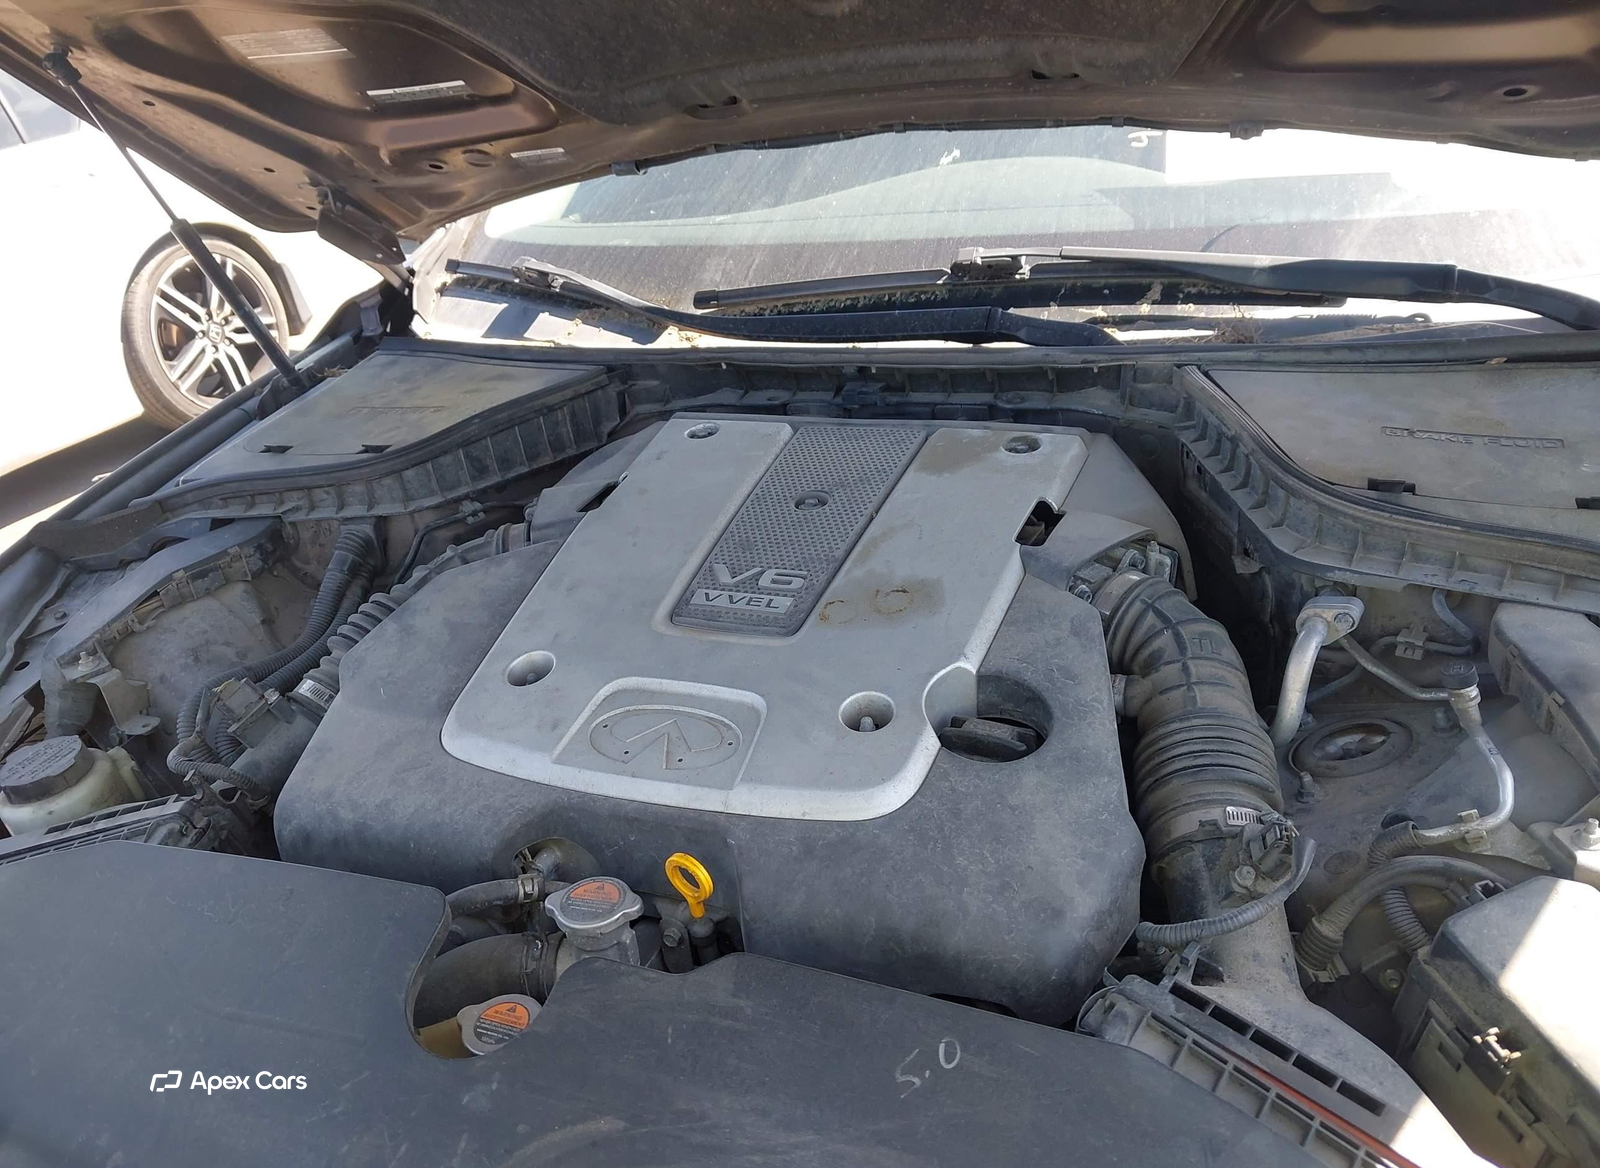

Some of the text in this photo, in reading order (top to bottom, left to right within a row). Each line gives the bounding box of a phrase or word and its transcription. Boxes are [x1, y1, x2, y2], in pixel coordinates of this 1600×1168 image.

[1384, 427, 1562, 449] BRAKE FLUID
[713, 563, 809, 591] V6
[704, 591, 781, 610] VVEL
